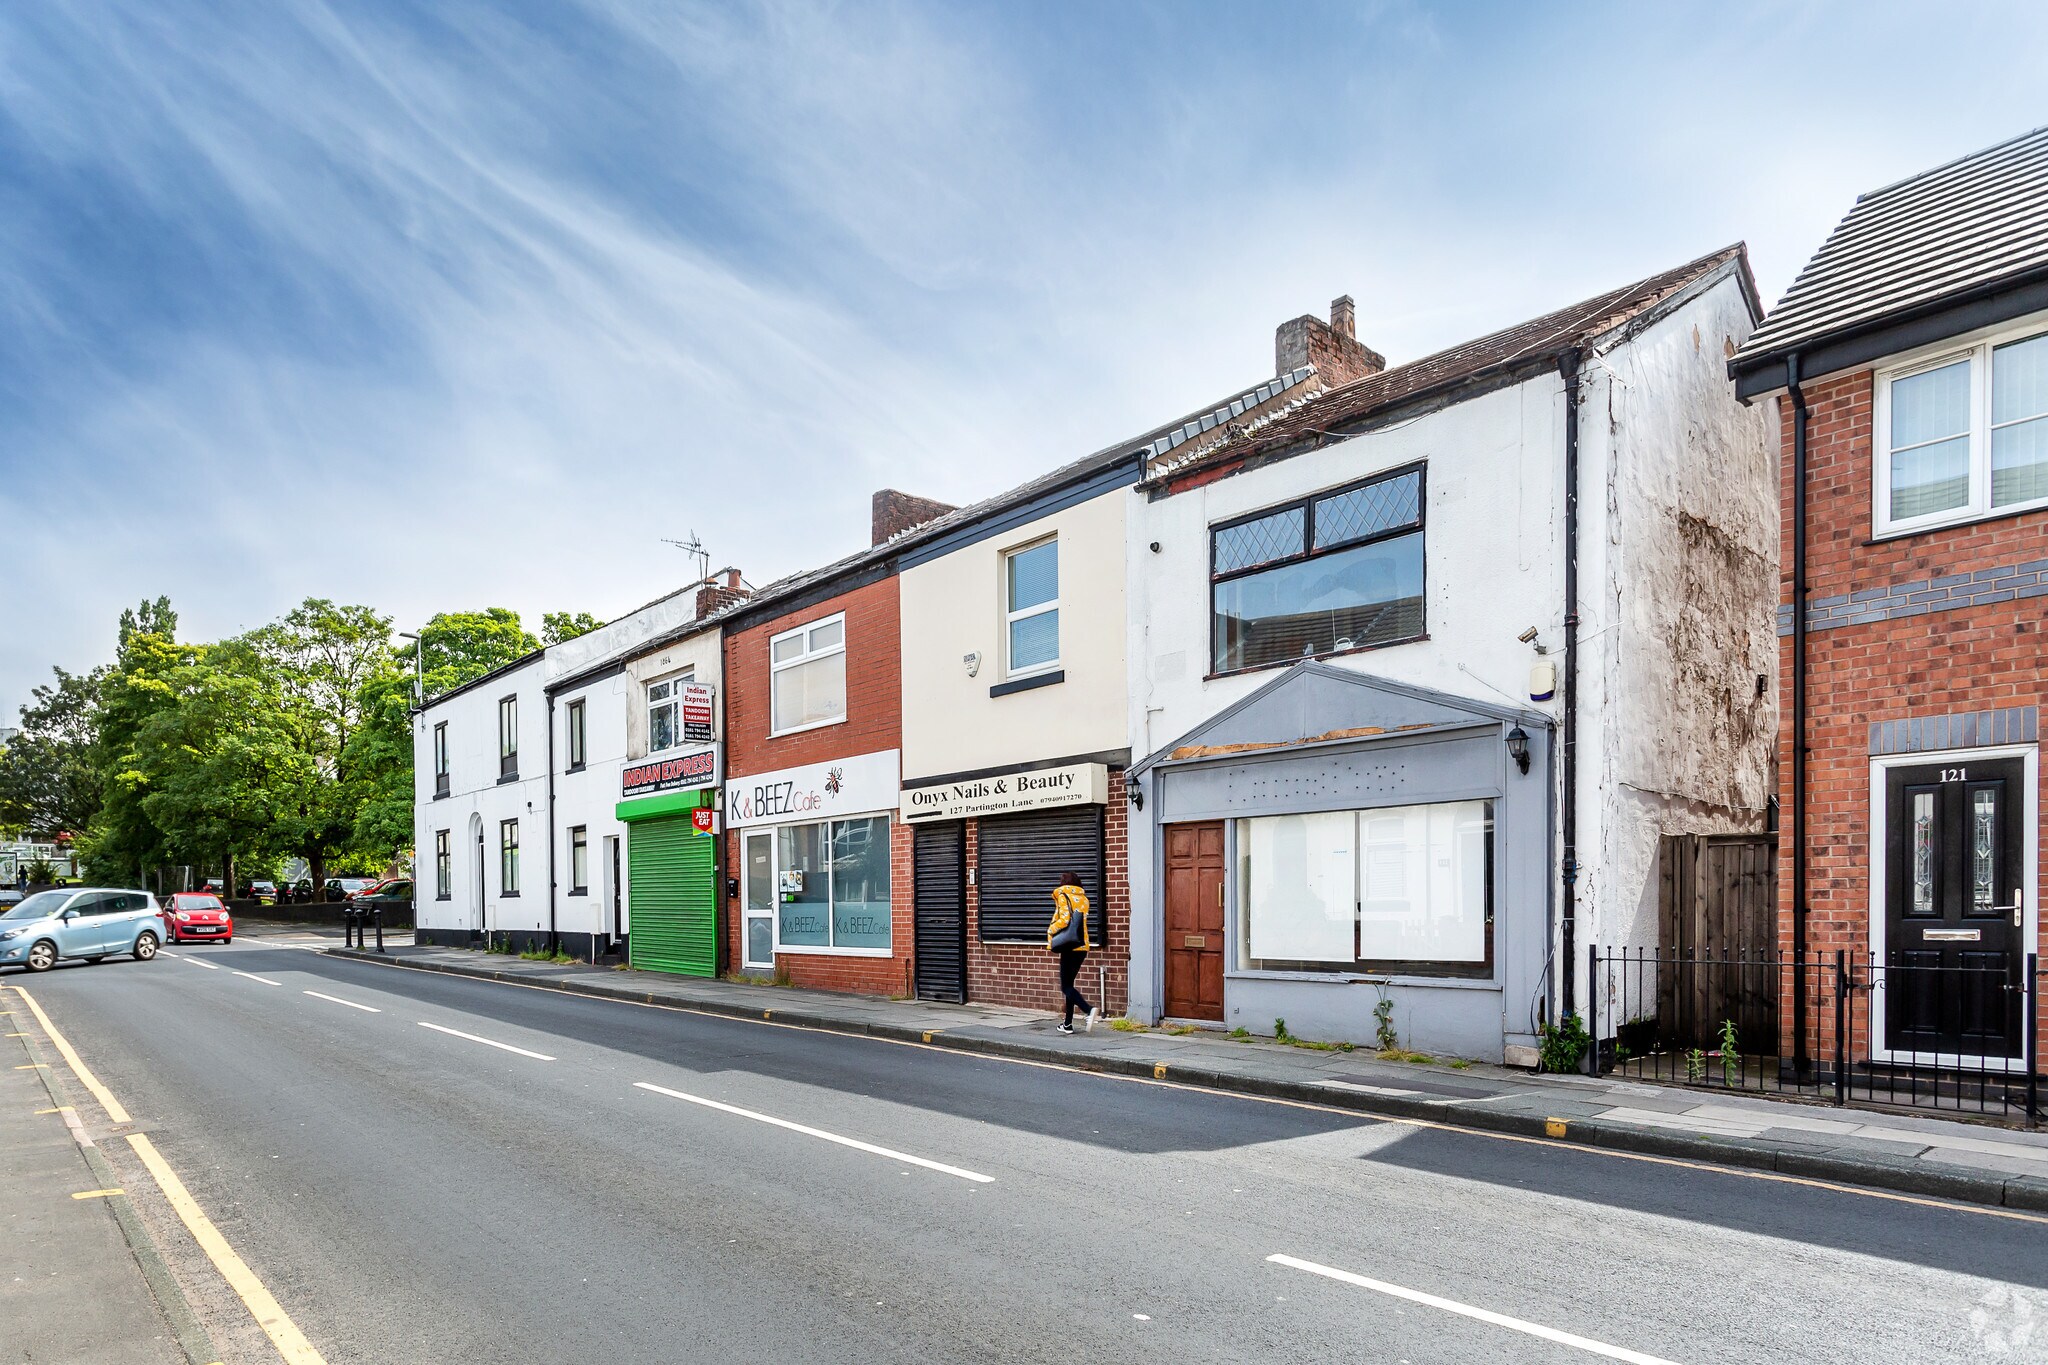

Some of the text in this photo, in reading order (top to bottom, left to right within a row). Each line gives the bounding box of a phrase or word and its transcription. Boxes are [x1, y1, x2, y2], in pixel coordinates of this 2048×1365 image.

[684, 695, 710, 704] Express
[686, 687, 707, 695] Indian
[623, 753, 713, 788] INDIAN EXPRESS
[1939, 768, 1967, 782] 121
[912, 772, 1075, 806] Onyx Nails & Beauty
[731, 781, 822, 820] K & BEEZ Cafe
[949, 806, 963, 815] 127
[965, 801, 1008, 813] Partington
[1012, 798, 1034, 807] Lane
[695, 811, 710, 819] JUST
[698, 818, 710, 826] EAT
[782, 916, 829, 934] K & BEEZ Cafe
[835, 916, 890, 935] K & BEEZ Cafe
